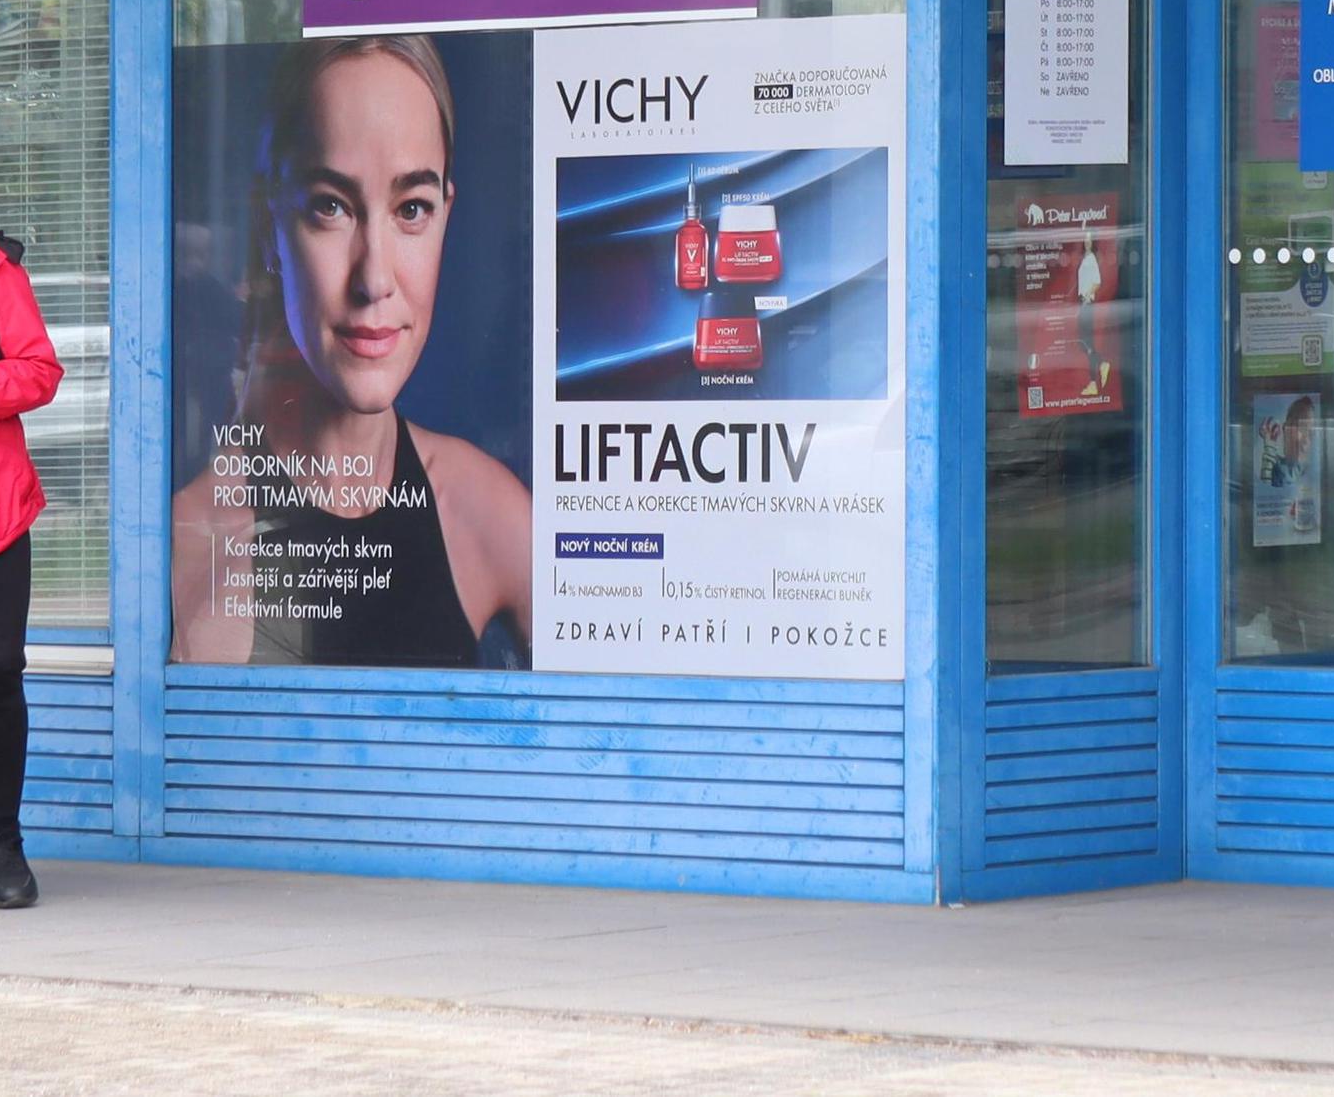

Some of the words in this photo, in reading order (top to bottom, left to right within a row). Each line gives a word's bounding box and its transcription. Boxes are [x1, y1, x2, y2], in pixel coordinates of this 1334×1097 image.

[1040, 10, 1049, 22] Út
[1040, 27, 1049, 37] St
[1040, 40, 1049, 52] Čt
[1040, 56, 1049, 66] Pá
[754, 69, 796, 84] ZNAČKA
[799, 65, 887, 82] DOPORUČOVANÁ
[1040, 72, 1049, 81] So
[1056, 70, 1089, 81] ZAVŘENO
[758, 87, 769, 98] 70
[771, 87, 789, 98] 000
[796, 84, 871, 98] DERMATOLOGY
[1040, 87, 1050, 96] Ne
[1056, 85, 1089, 96] ZAVŘENO
[556, 74, 709, 125] VICHY
[754, 103, 760, 114] Z
[763, 100, 802, 114] CELÉHO
[570, 128, 697, 140] LABORATOIRES
[735, 240, 758, 248] VICHY
[687, 250, 697, 262] V
[711, 374, 734, 384] NOČNÍ
[736, 375, 754, 384] KRÉM
[213, 424, 265, 446] VICHY
[555, 422, 817, 484] LIFTACTIV
[213, 450, 305, 477] ODBORNÍK
[311, 456, 338, 477] NA
[343, 455, 374, 478] BOJ
[214, 485, 257, 507] PROTI
[262, 481, 335, 508] TMAVÝM
[340, 480, 427, 509] SKVRNÁM
[556, 495, 621, 511] PREVENCE
[624, 495, 634, 511] A
[638, 495, 697, 512] KOREKCE
[701, 492, 766, 512] TMAVÝCH
[770, 496, 815, 512] SKVRN
[819, 497, 829, 512] A
[833, 493, 885, 513] VRÁSEK
[224, 536, 283, 558] Korekce
[288, 536, 349, 564] tmavých
[354, 536, 392, 558] skvrn
[560, 537, 590, 552] NOVÝ
[594, 537, 628, 553] NOČNÍ
[631, 538, 659, 553] KRÉM
[223, 568, 278, 594] Jasnější
[283, 575, 293, 588] a
[298, 568, 358, 594] zářivější
[362, 567, 392, 595] pleť
[777, 568, 820, 583] POMÁHÁ
[578, 585, 631, 598] NIACINAMID
[633, 586, 643, 598] B3
[704, 585, 729, 600] ČISTÝ
[730, 587, 766, 600] RETINOL
[777, 588, 836, 601] REGENERACI
[839, 587, 872, 602] BUNĚK
[224, 597, 283, 618] Efektivní
[287, 597, 343, 619] formule
[556, 618, 643, 643] ZDRAVÍ
[662, 619, 727, 644] PATŘÍ
[746, 626, 751, 644] I
[770, 622, 888, 647] POKOŽCE
